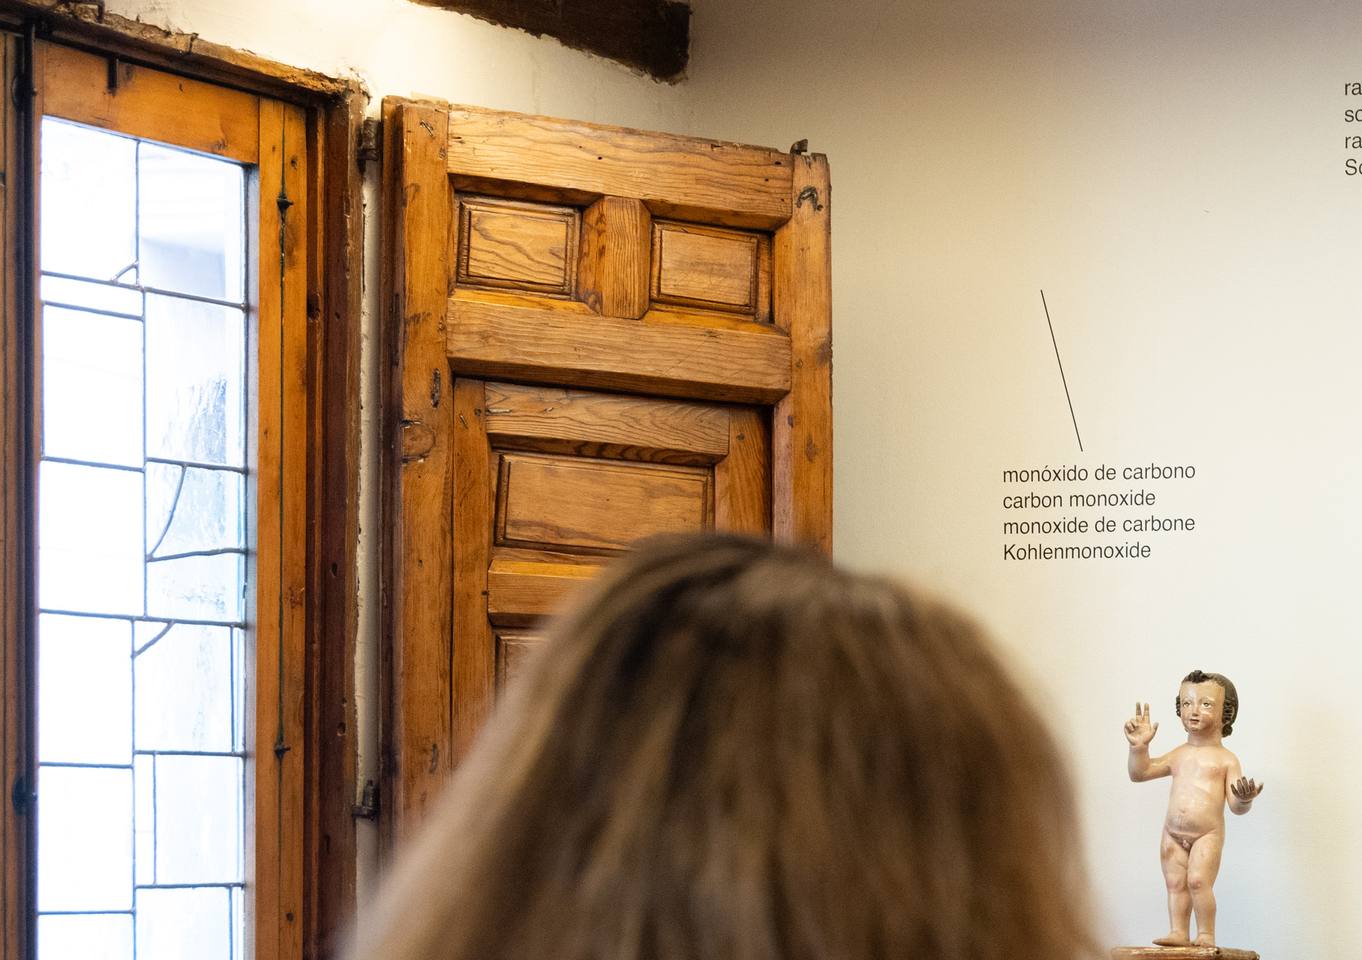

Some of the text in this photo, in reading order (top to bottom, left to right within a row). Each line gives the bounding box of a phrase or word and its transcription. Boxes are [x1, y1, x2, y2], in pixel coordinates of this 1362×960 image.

[1002, 463, 1195, 482] monóxido de carbono
[1002, 489, 1155, 509] carbon monoxide
[1003, 515, 1195, 534] monoxide de carbone
[1003, 541, 1151, 559] Kohlenmonoxide
